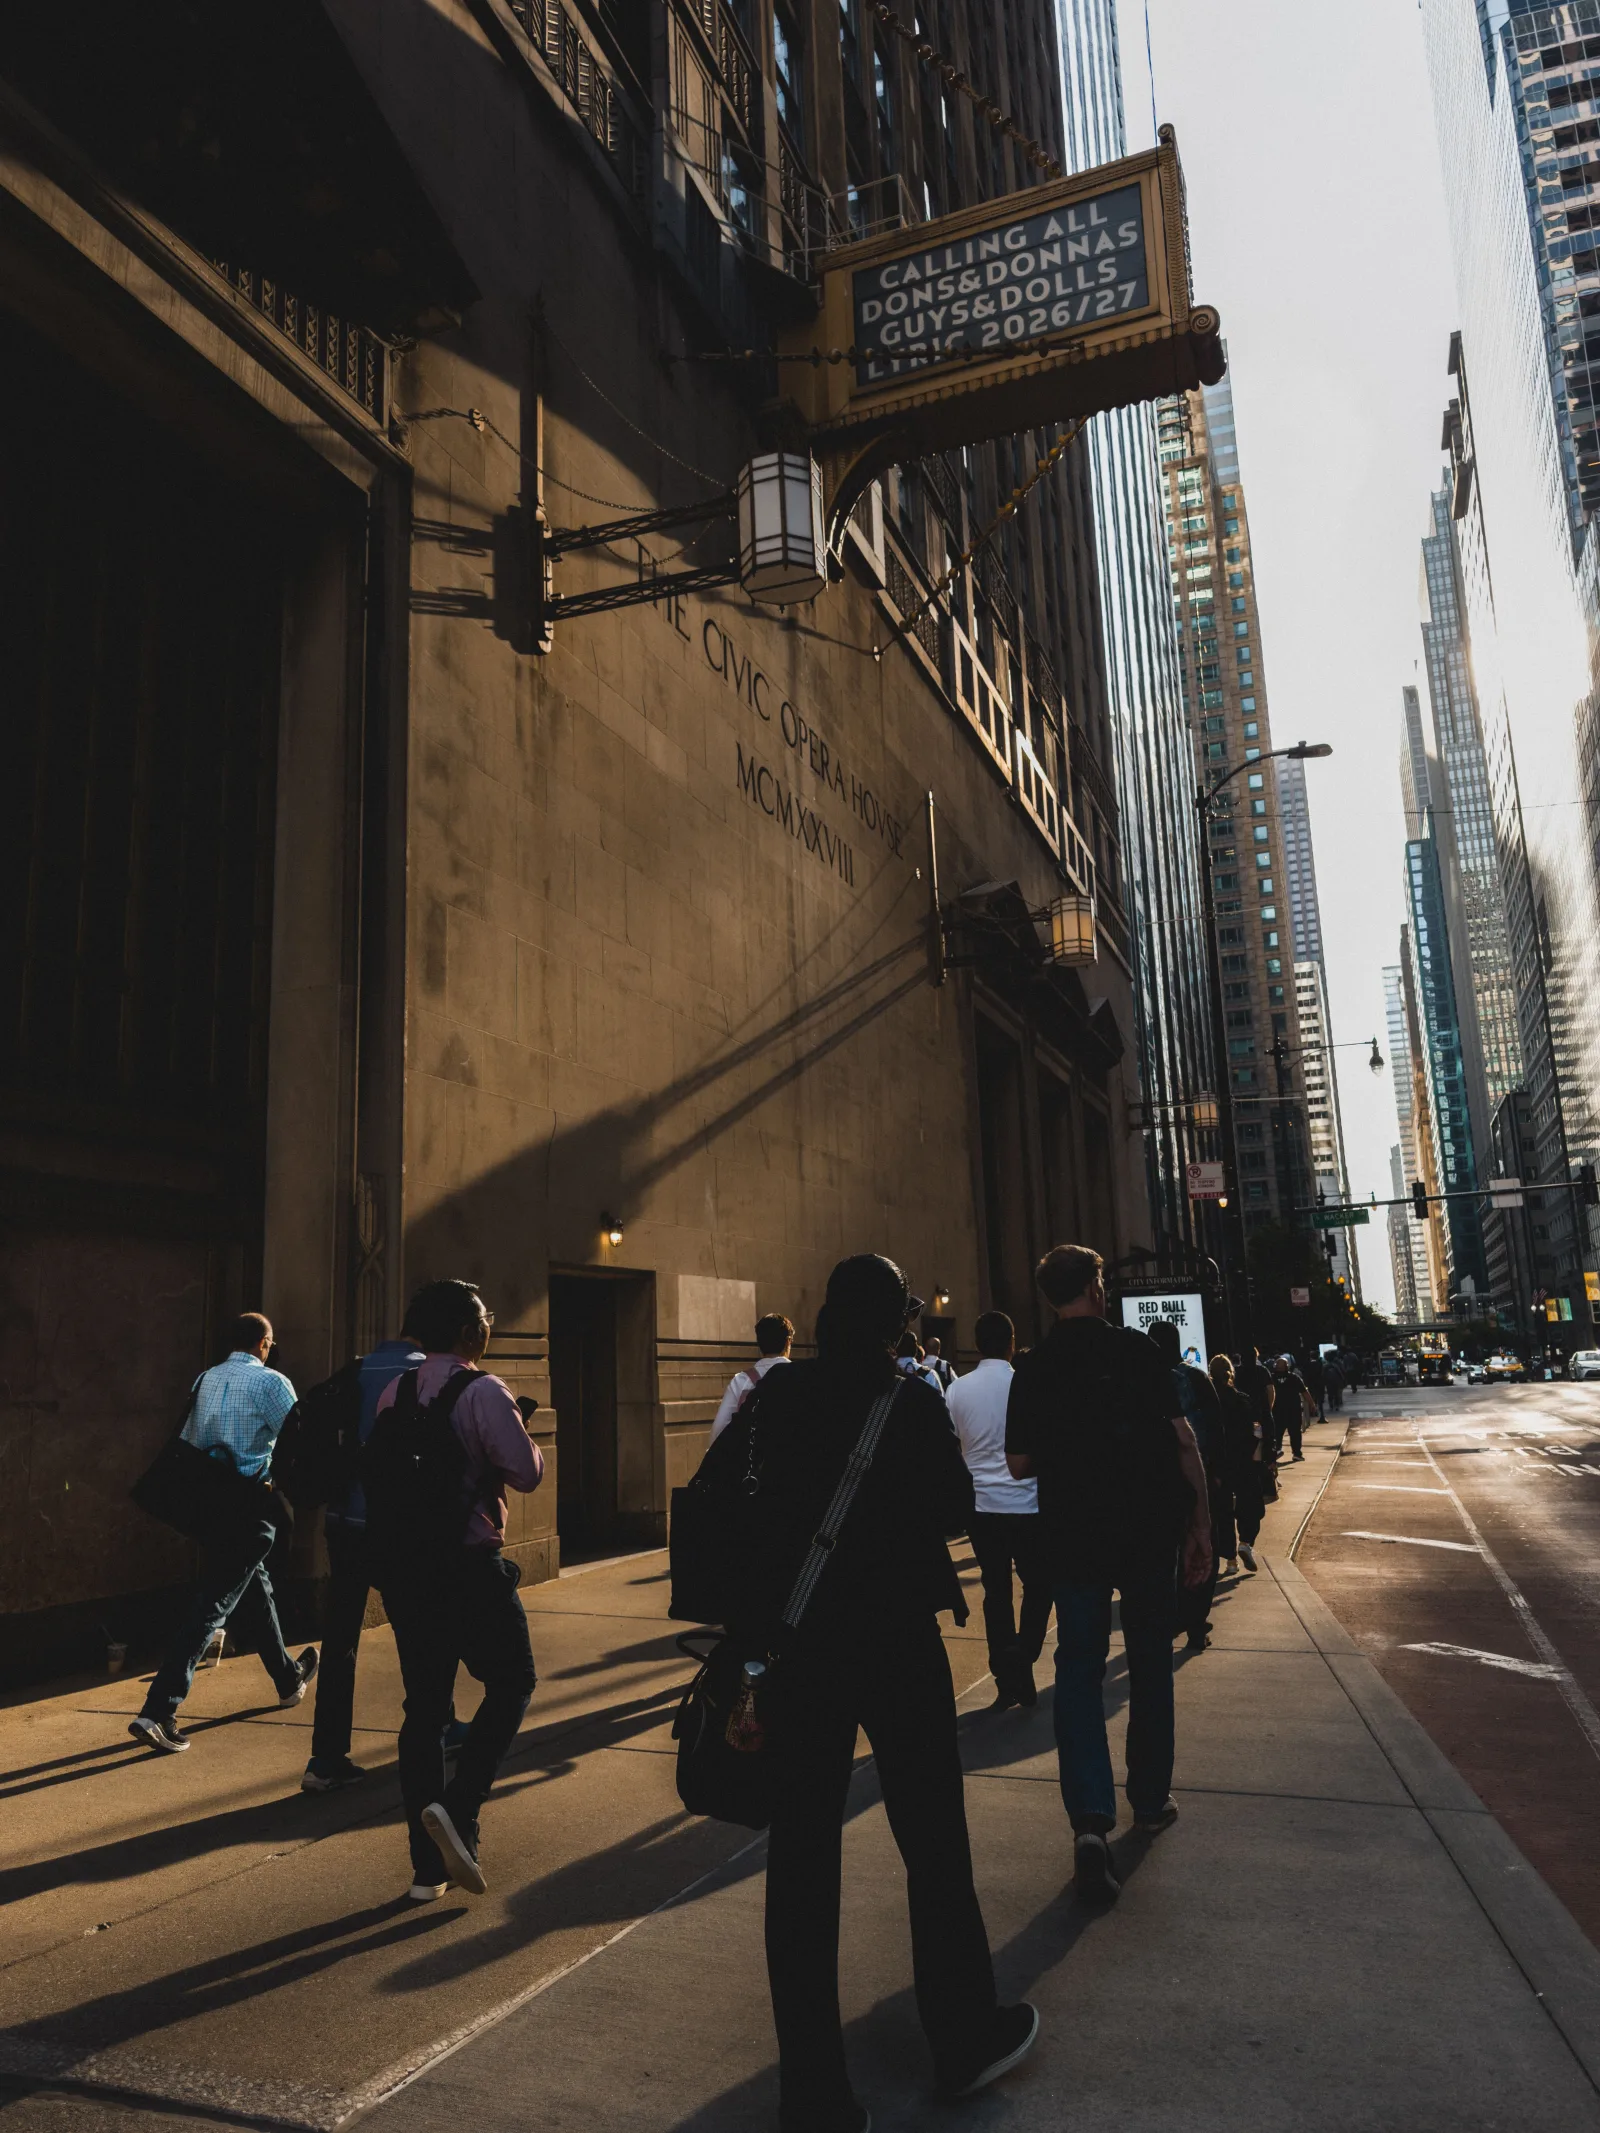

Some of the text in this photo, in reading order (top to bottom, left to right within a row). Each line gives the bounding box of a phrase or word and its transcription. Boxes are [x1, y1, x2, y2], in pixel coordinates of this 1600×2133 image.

[862, 220, 1139, 324] DONS&DONNAS
[879, 202, 1108, 289] CALLING ALL
[880, 257, 1118, 346] GUYS&DOLLS
[981, 281, 1137, 348] 2026/27
[703, 618, 770, 721] CIVIC
[780, 701, 847, 803] OPERA
[736, 740, 854, 888] MCMXXVIII
[1324, 1212, 1354, 1221] WACKER
[1128, 1276, 1194, 1286] CITY INFORMATION
[1138, 1300, 1186, 1314] RED BULL
[1508, 1464, 1600, 1477] NLY
